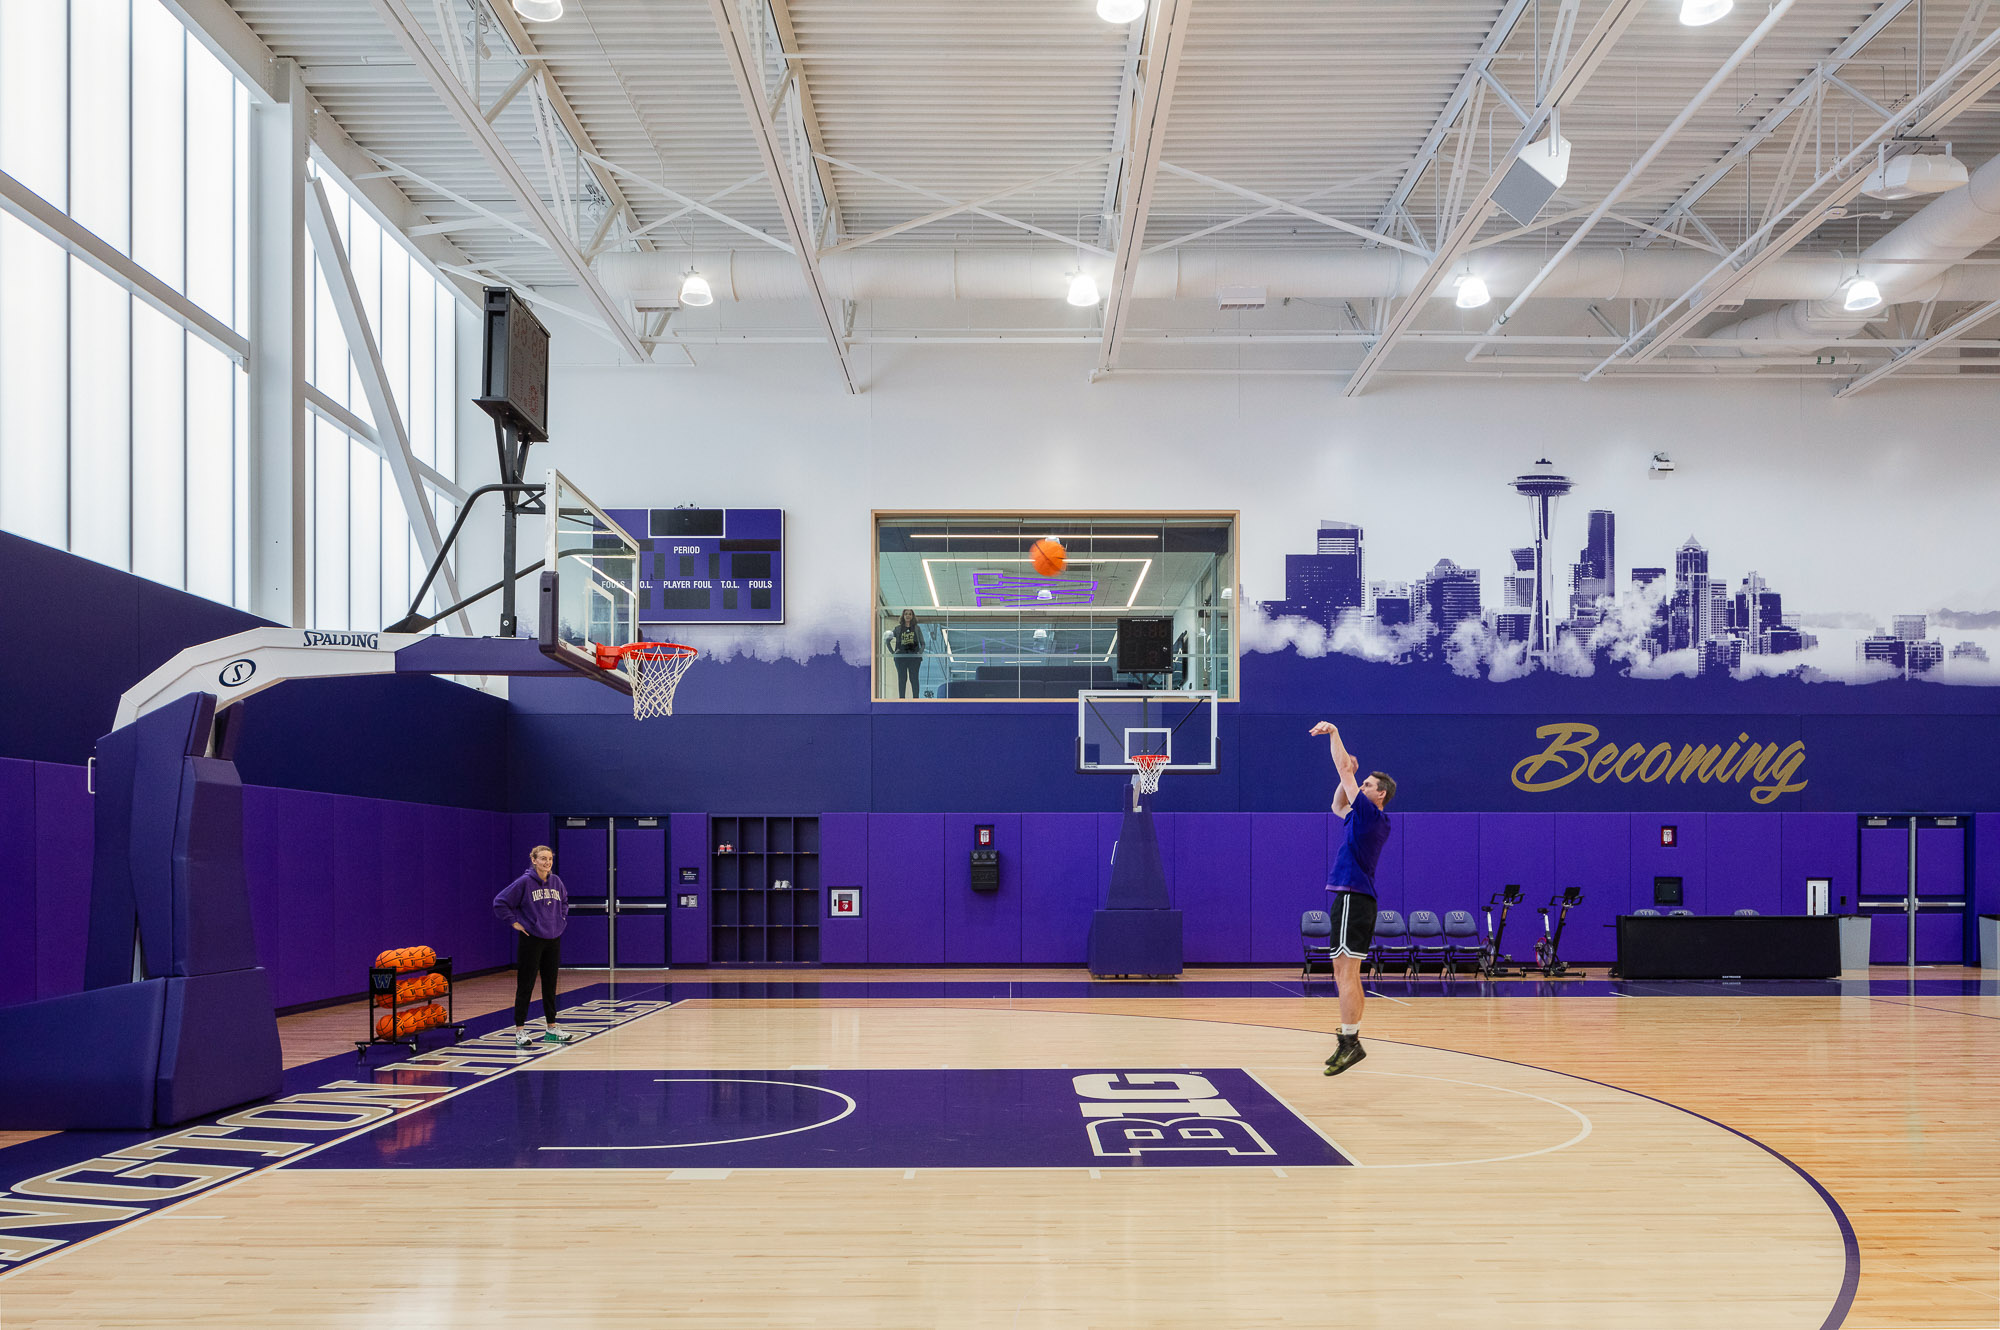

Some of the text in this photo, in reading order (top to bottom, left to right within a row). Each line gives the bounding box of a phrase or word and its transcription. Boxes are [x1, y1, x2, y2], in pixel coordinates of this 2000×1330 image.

[673, 546, 701, 554] PERIOD
[663, 580, 691, 589] PLAYER
[693, 580, 712, 589] FOUL
[720, 580, 740, 589] T.O.L.
[748, 580, 773, 589] FOULS
[303, 630, 378, 650] SPALDING
[1511, 722, 1809, 804] Becoming
[372, 973, 393, 989] W
